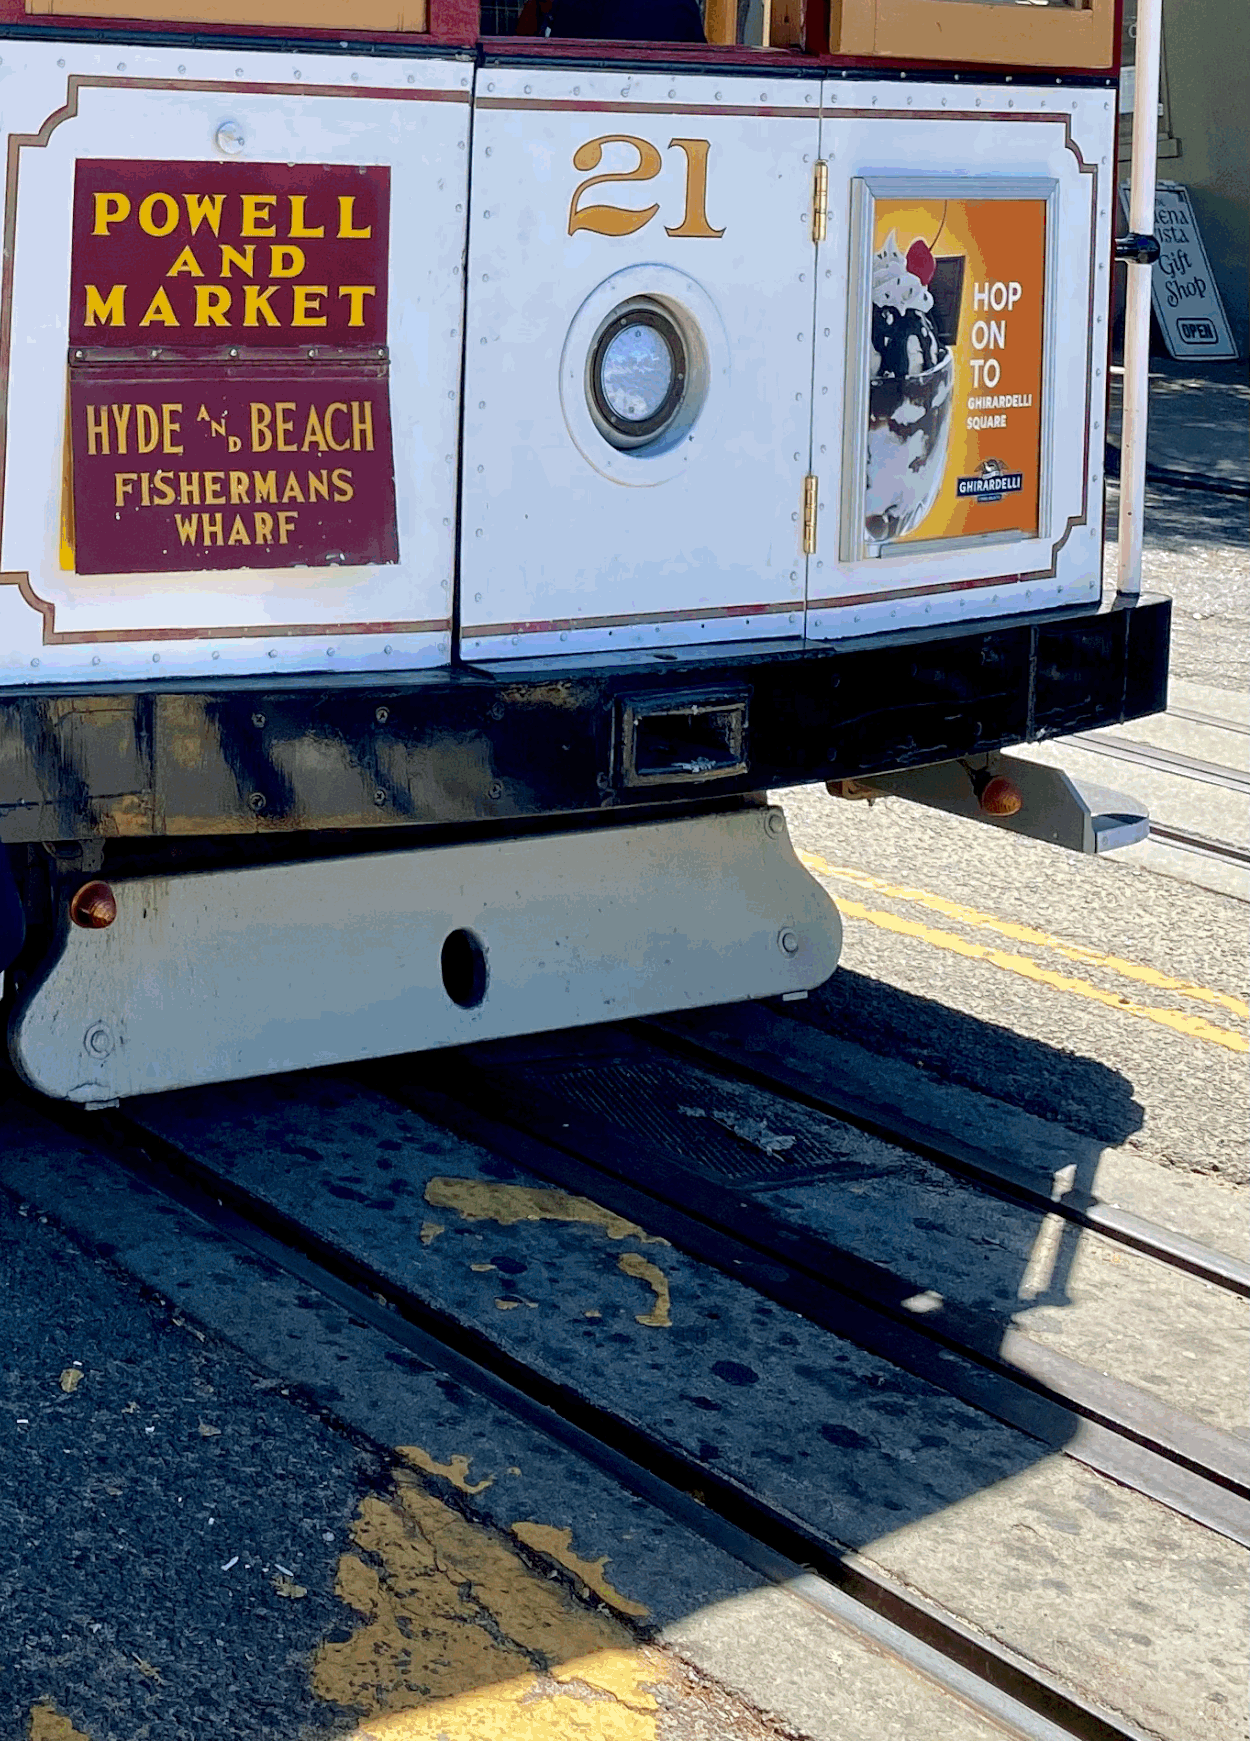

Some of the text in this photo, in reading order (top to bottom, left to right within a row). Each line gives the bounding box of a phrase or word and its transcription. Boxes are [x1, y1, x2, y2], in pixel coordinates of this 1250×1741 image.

[567, 134, 727, 239] 21
[91, 191, 372, 239] POWELL
[165, 244, 306, 278] AND
[1158, 249, 1192, 279] Gift
[83, 284, 376, 327] MARKET
[973, 281, 1022, 311] HOP
[1166, 276, 1207, 308] Shop
[971, 320, 1006, 350] ON
[1181, 323, 1214, 339] OPEN
[970, 358, 1000, 388] TO
[967, 394, 1032, 410] GHIRARDELLI
[86, 401, 375, 455] HYDE AND BEACH
[967, 414, 1007, 431] SQUARE
[115, 468, 354, 507] FISHERMANS
[958, 474, 1021, 494] GHIRARDELLI
[174, 510, 299, 547] WHARF
